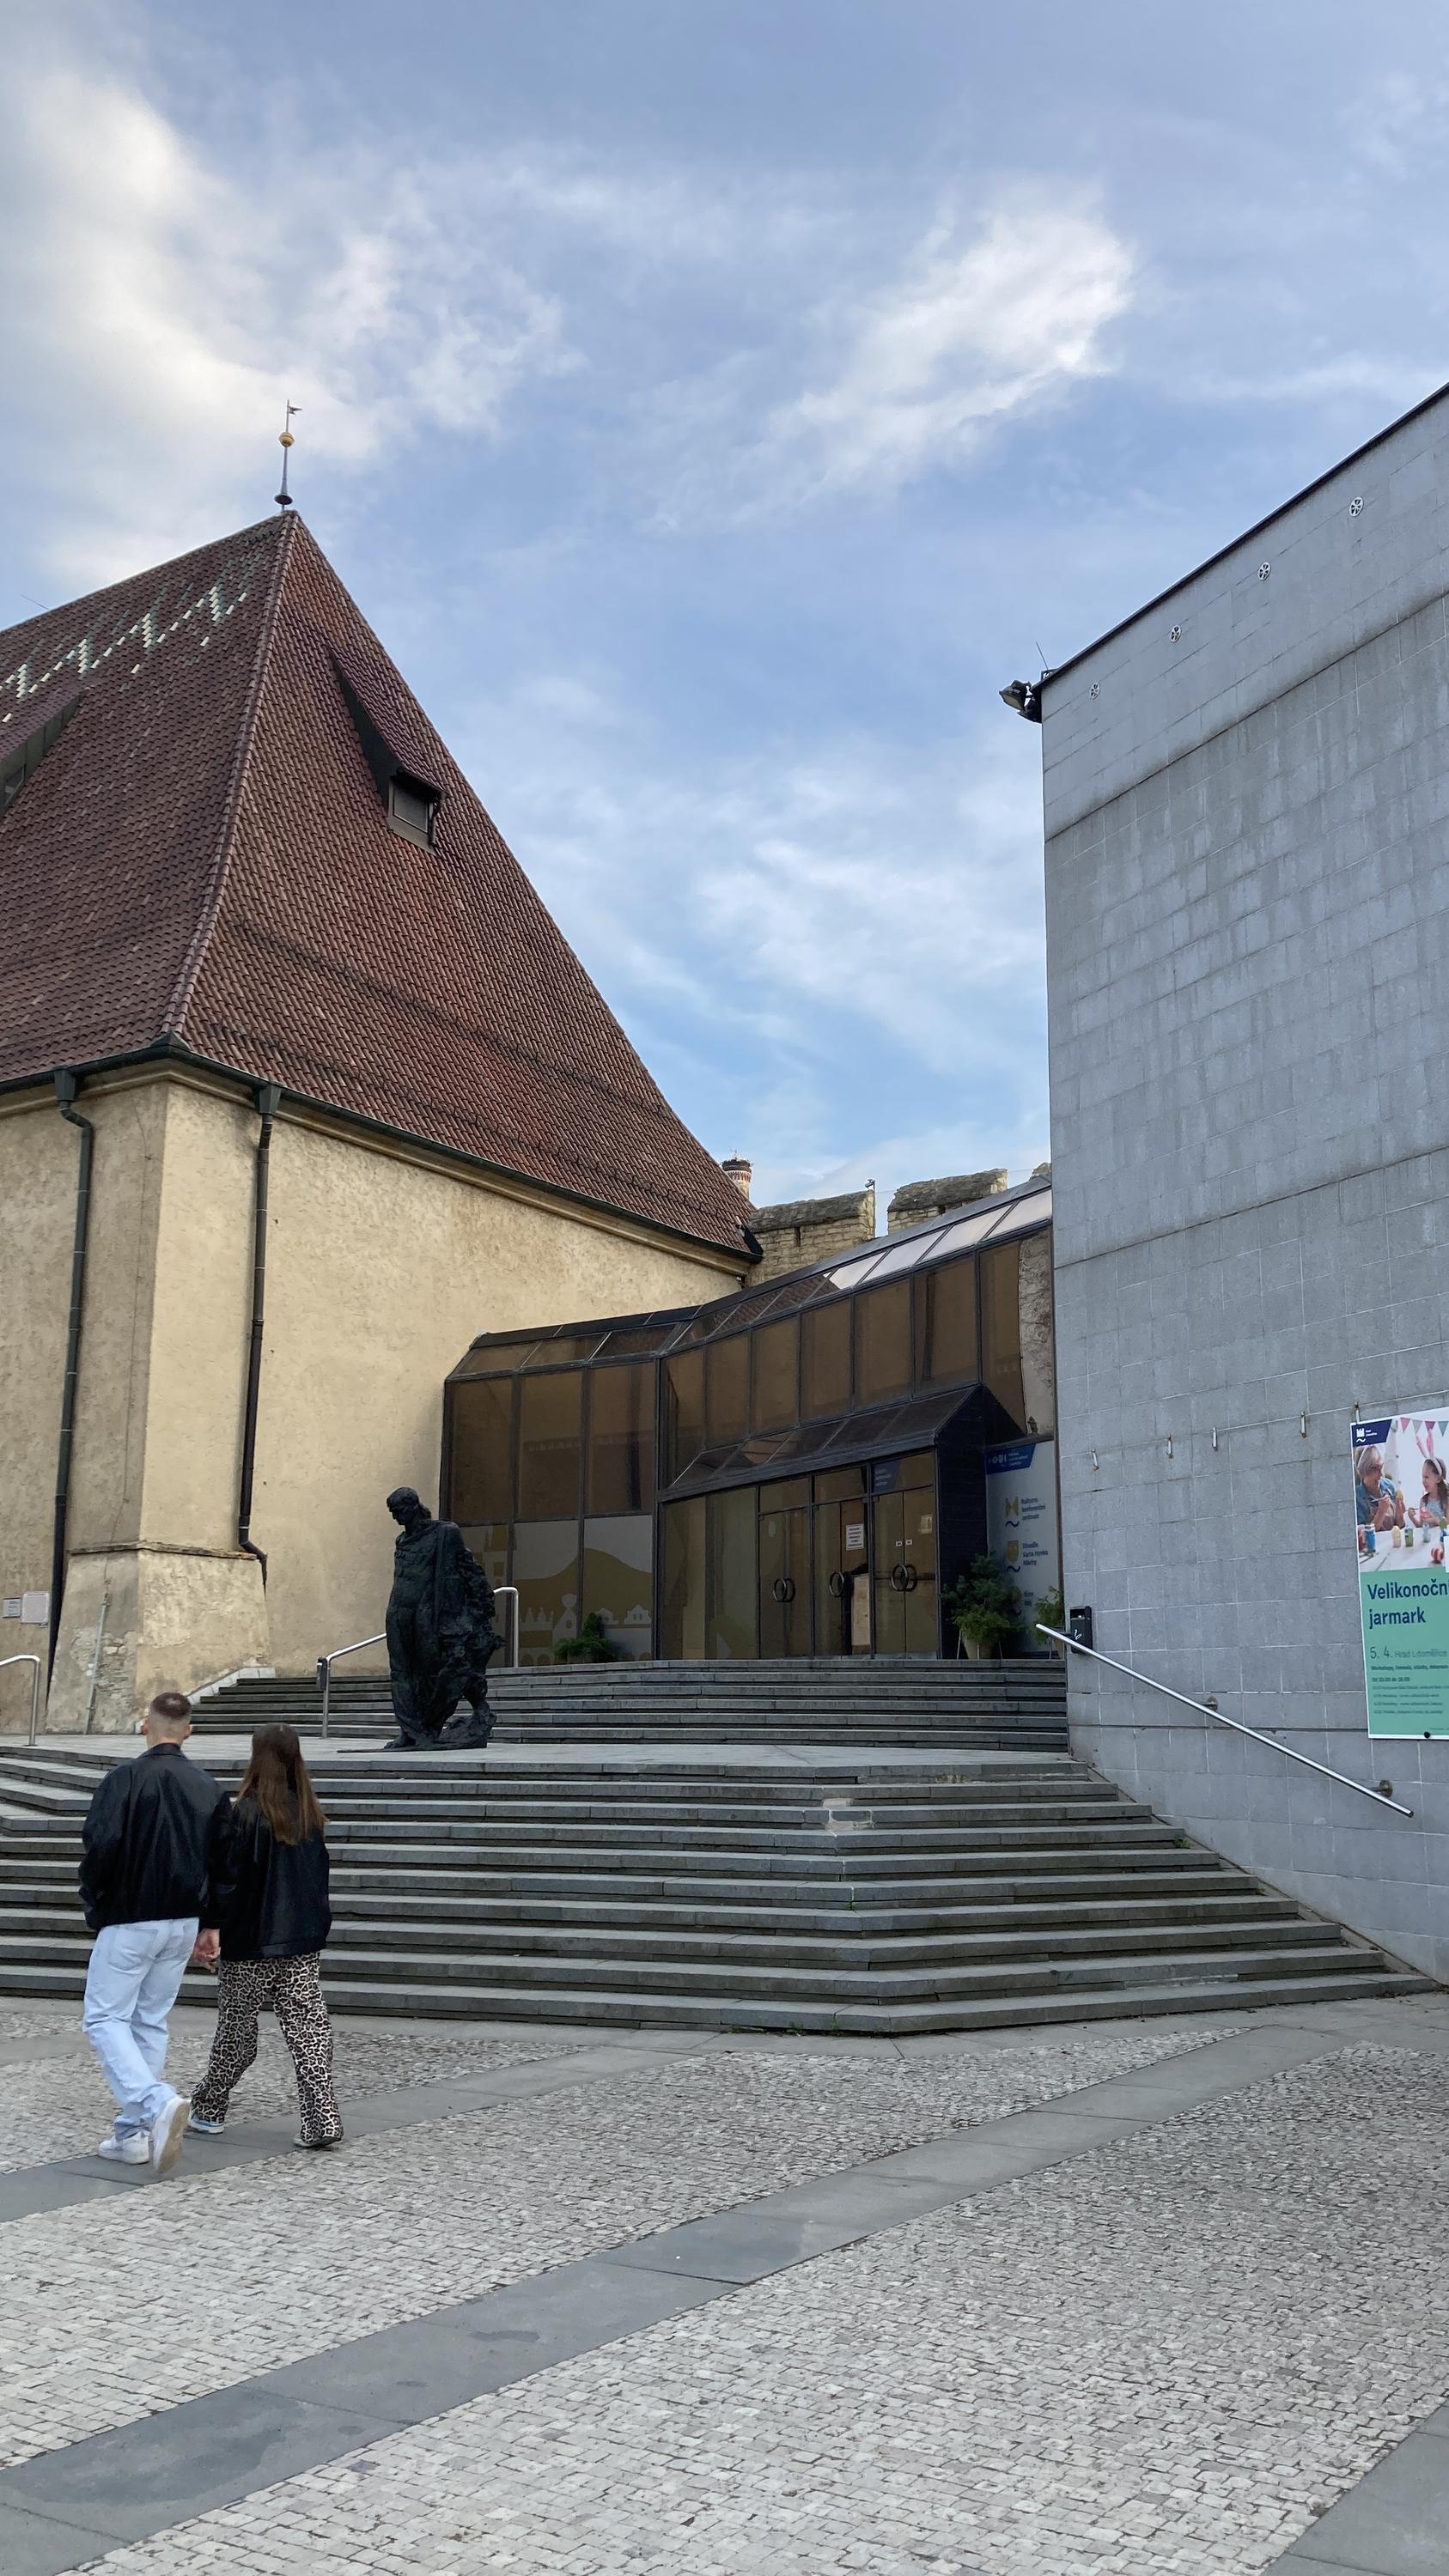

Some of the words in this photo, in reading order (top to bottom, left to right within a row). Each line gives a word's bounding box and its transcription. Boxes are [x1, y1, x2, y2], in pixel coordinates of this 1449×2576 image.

[1367, 1578, 1449, 1600] Velikonočn
[1369, 1607, 1426, 1630] jarmark
[1370, 1646, 1379, 1659] 5.
[1384, 1646, 1393, 1658] 4.
